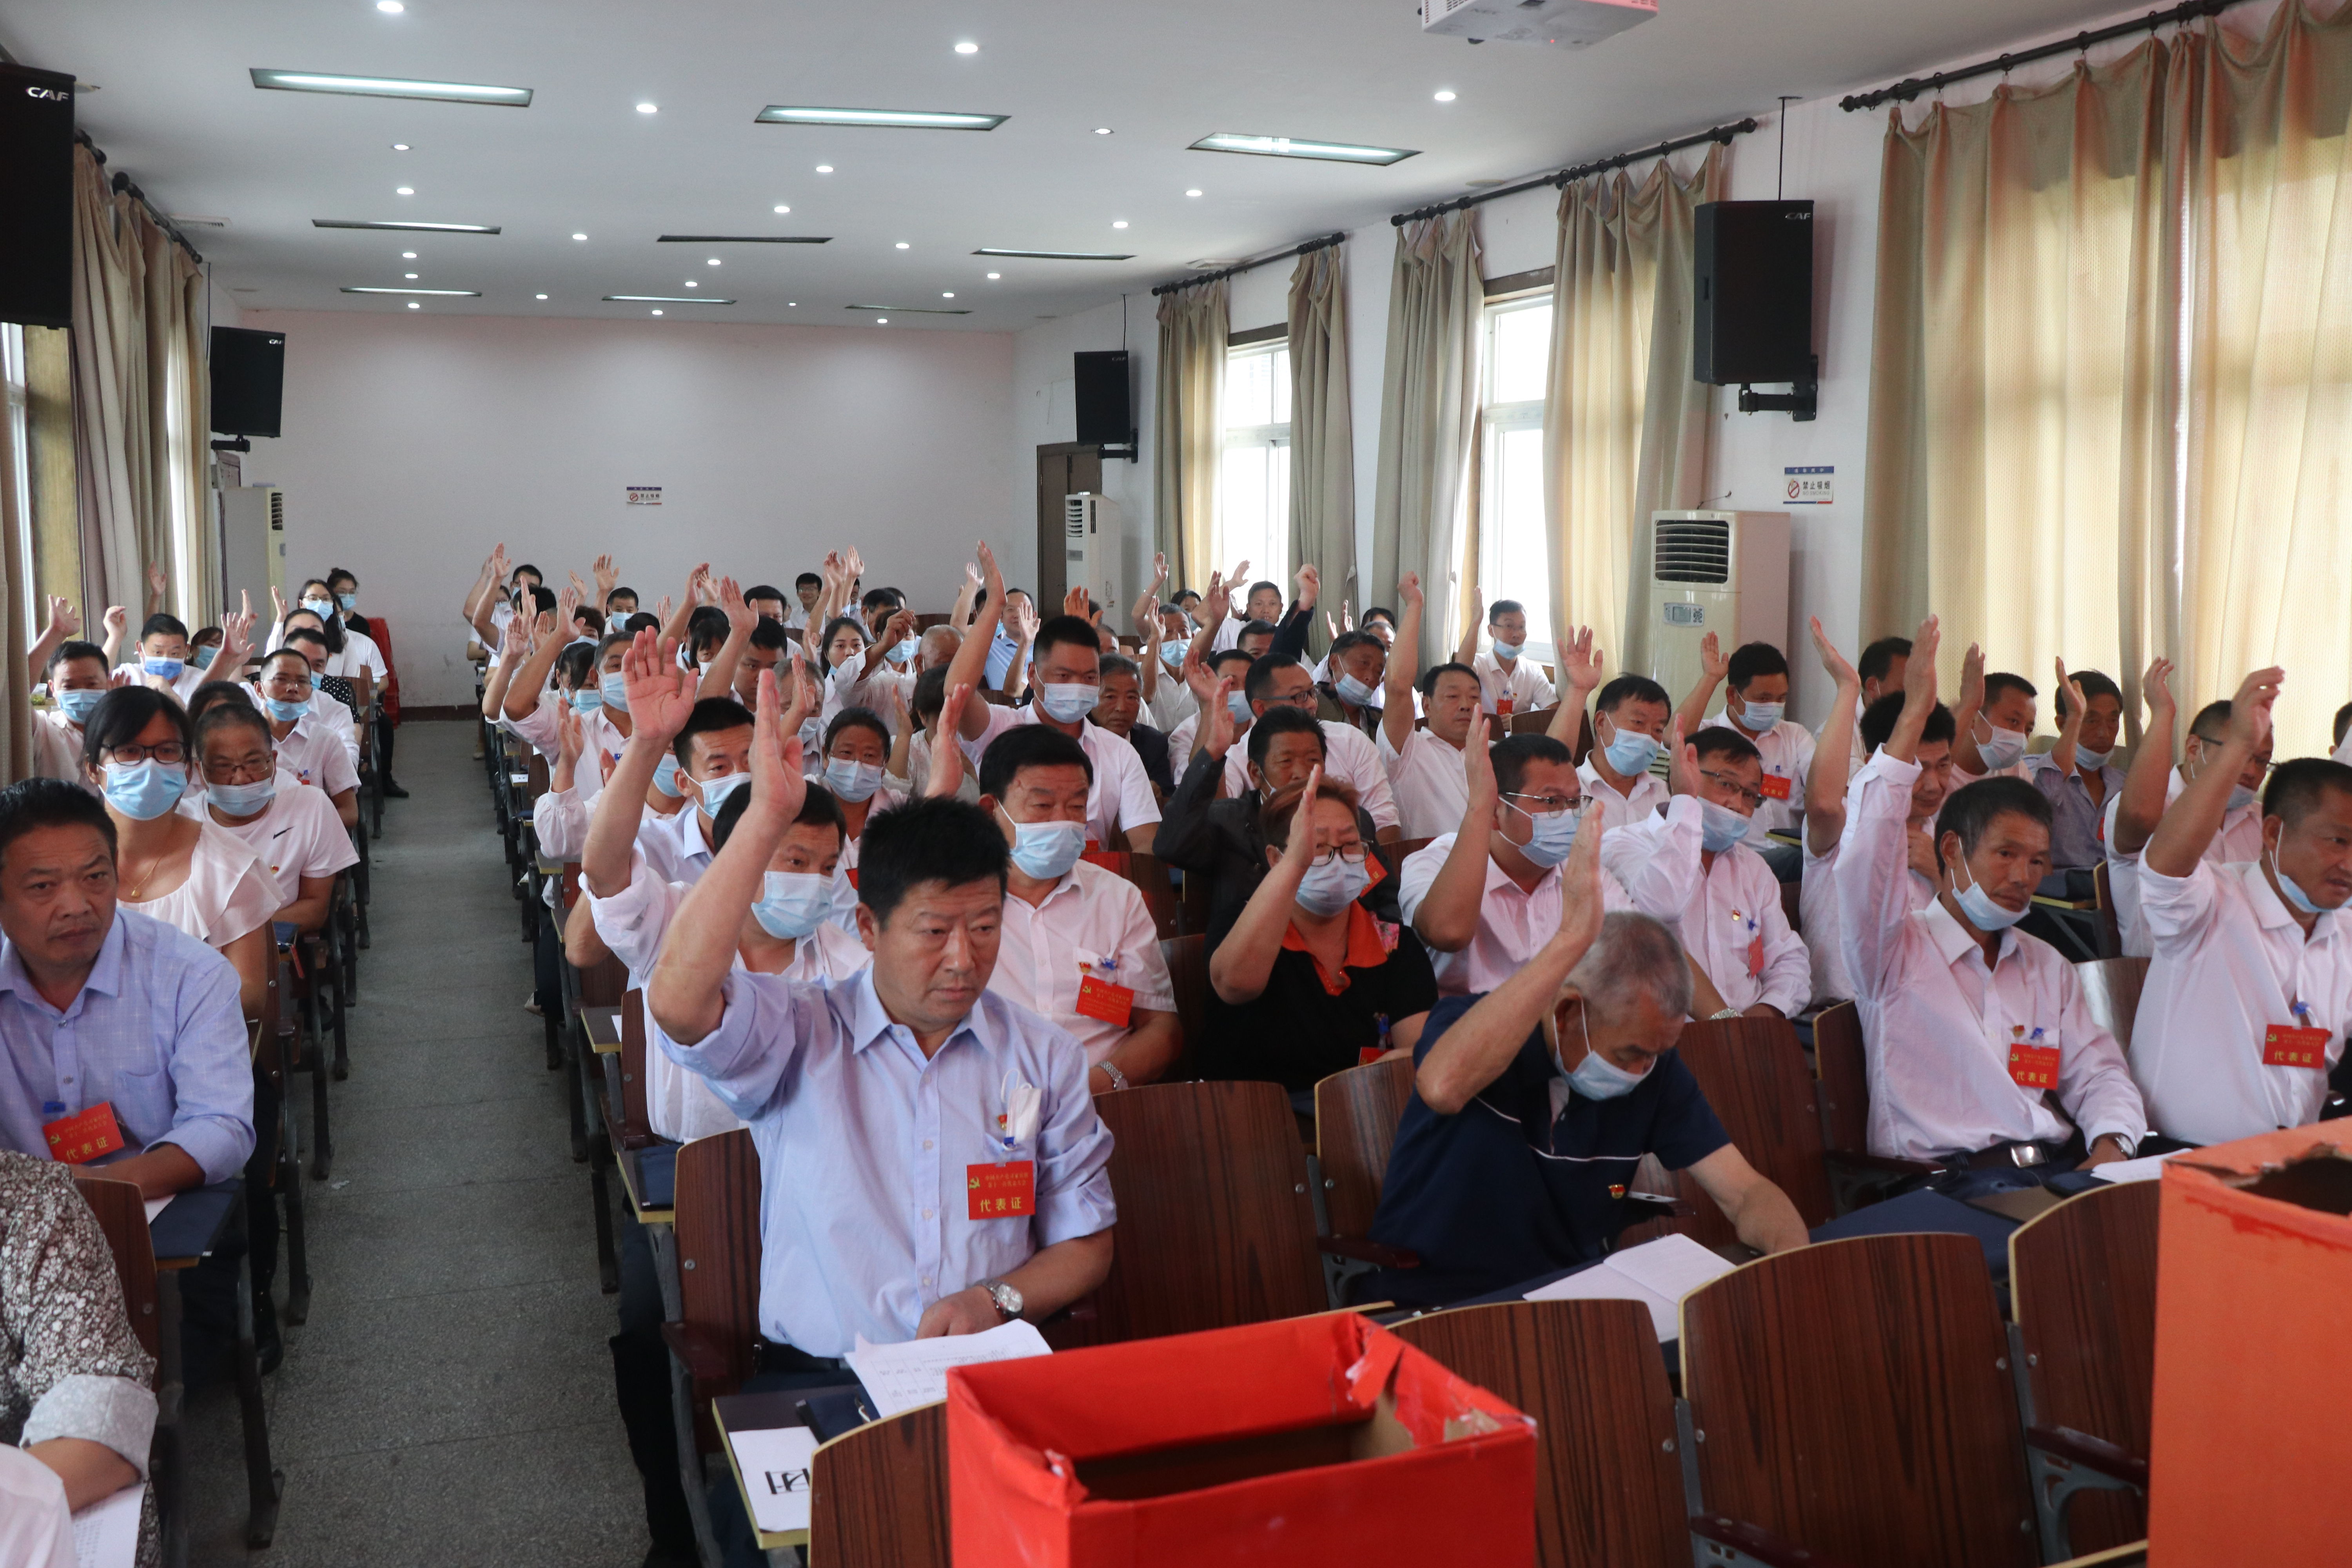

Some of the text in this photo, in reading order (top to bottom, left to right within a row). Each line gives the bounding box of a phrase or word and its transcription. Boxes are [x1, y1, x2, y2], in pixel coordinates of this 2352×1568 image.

[25, 87, 69, 101] CAF
[1803, 481, 1830, 490] 禁止吸烟
[2274, 1050, 2312, 1063] 代表证
[2016, 1070, 2048, 1083] 代表证
[66, 1136, 108, 1160] 代表证
[980, 1197, 1022, 1212] 代表证
